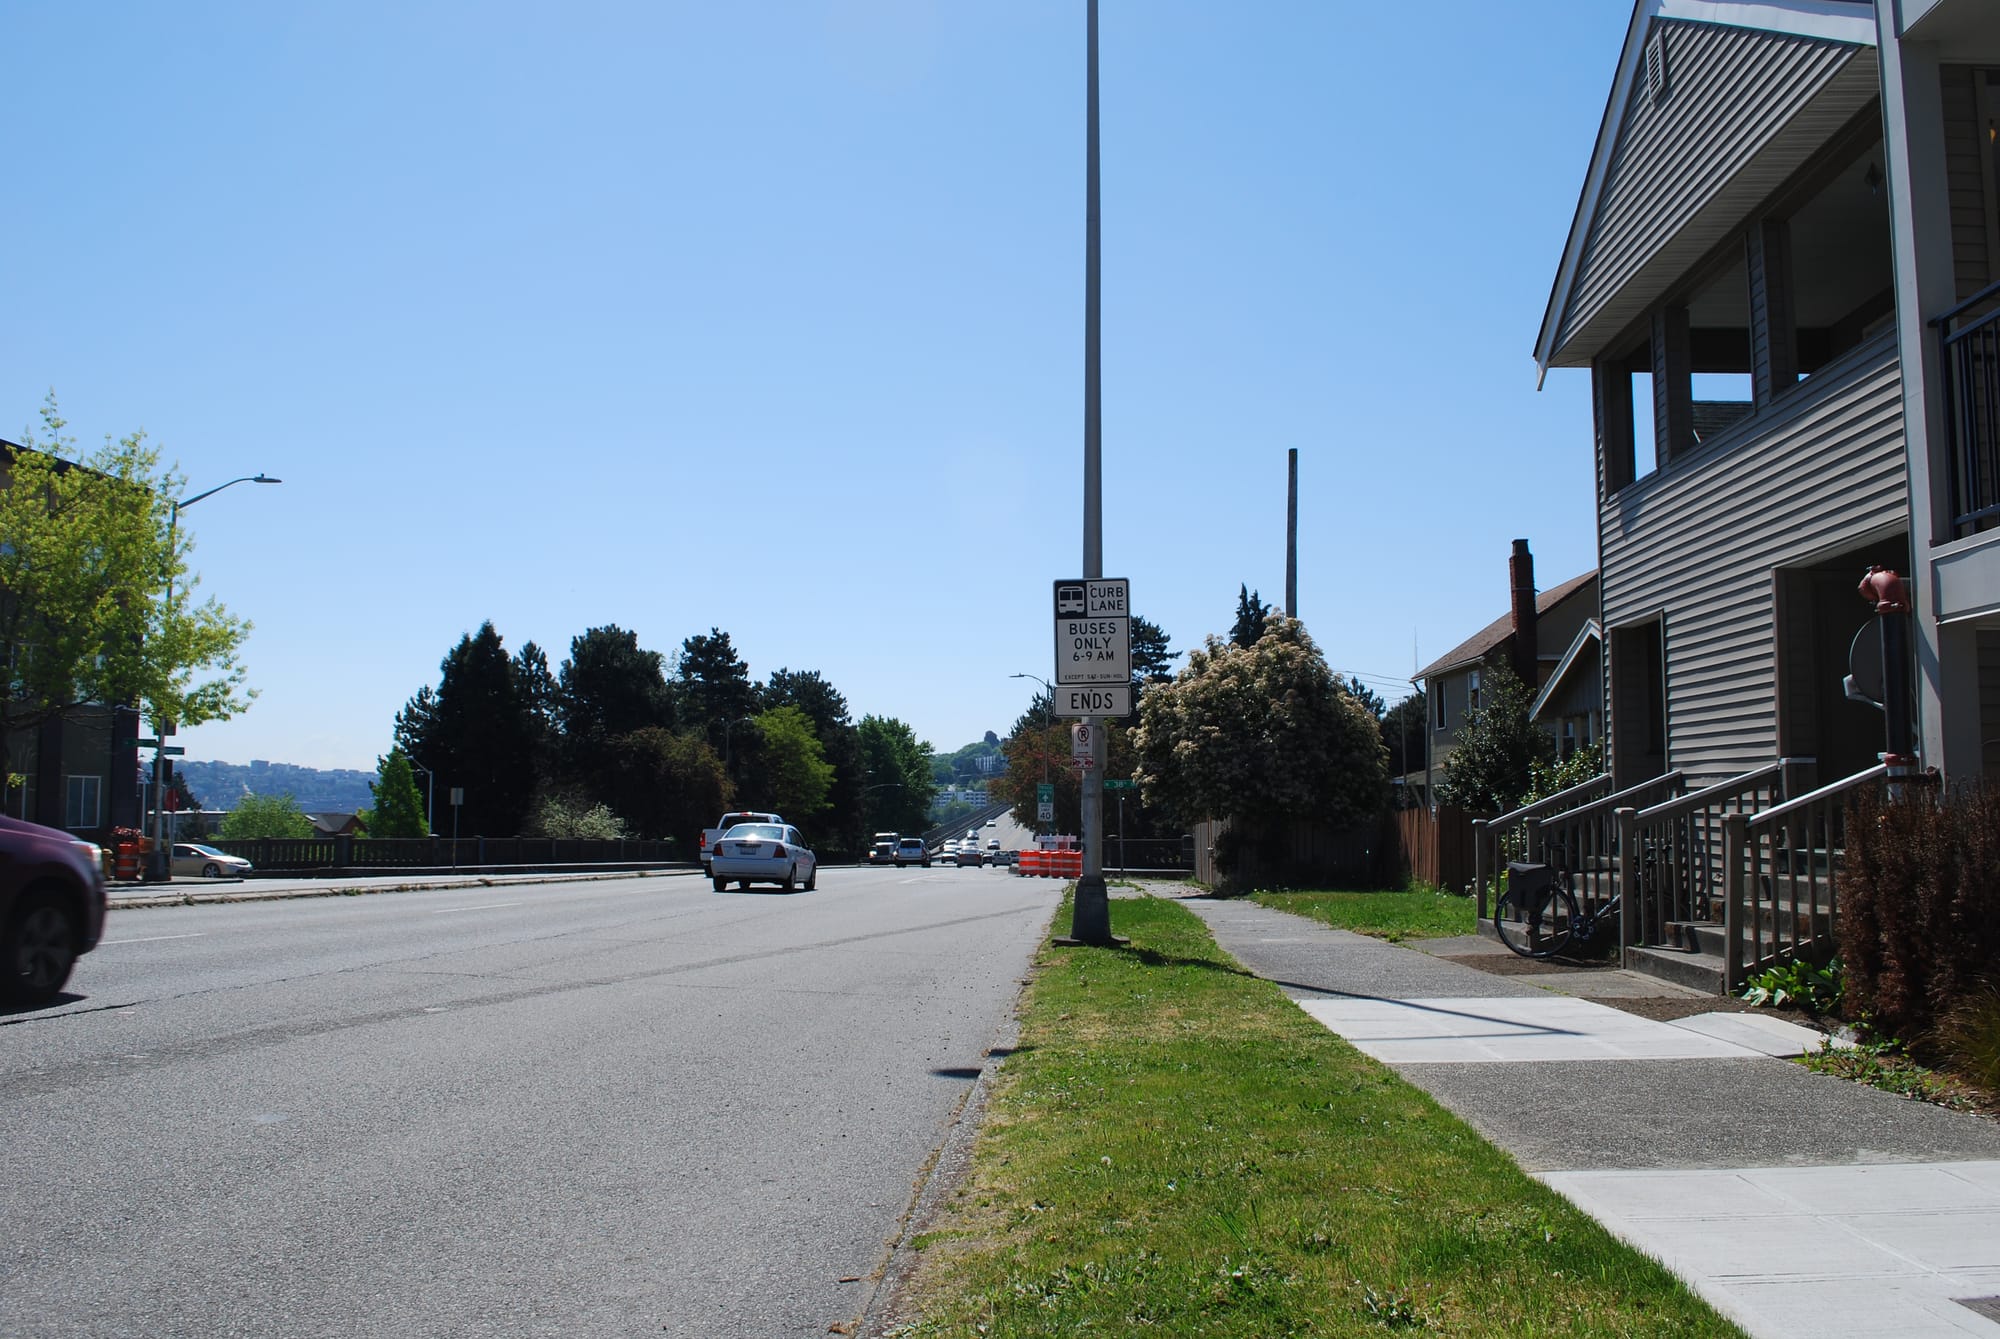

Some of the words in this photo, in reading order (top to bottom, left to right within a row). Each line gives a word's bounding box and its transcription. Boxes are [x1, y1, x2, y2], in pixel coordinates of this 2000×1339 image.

[1090, 587, 1124, 598] CURB
[1091, 600, 1124, 611] LANE
[1069, 622, 1116, 635] BUSES
[1074, 637, 1111, 650] ONLY
[1073, 651, 1092, 662] 6-9
[1097, 651, 1114, 661] AM
[1071, 693, 1113, 710] ENDS
[1040, 812, 1051, 820] 40
